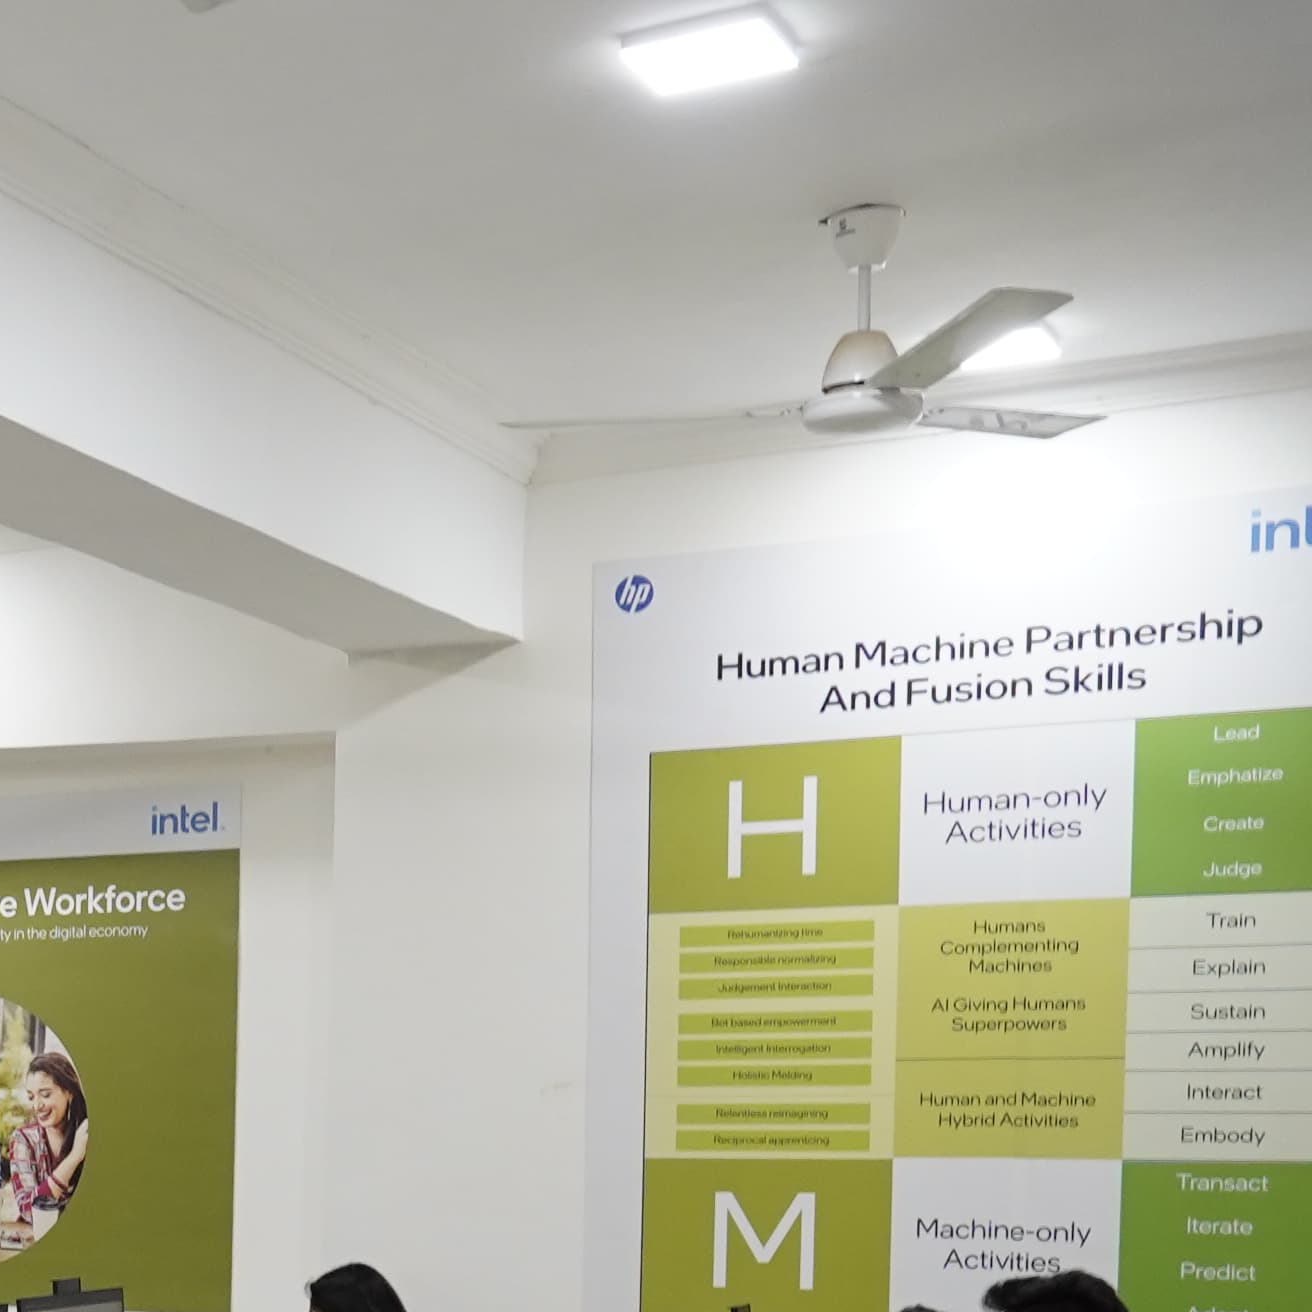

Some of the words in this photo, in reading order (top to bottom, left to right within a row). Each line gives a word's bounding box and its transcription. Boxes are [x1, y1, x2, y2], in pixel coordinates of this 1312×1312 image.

[615, 574, 654, 613] hp
[717, 650, 845, 681] Human
[854, 634, 1014, 670] Machine
[1025, 609, 1264, 655] Partnership
[820, 682, 896, 715] And
[906, 673, 1033, 707] Fusion
[1044, 662, 1147, 694] Skills
[1213, 724, 1260, 743] Lead
[1187, 764, 1283, 788] Emphatize
[923, 782, 1107, 816] Human-only
[150, 801, 219, 836] intel
[727, 775, 818, 879] H
[1203, 815, 1265, 834] Create
[945, 817, 1083, 845] Activities
[1203, 859, 1263, 881] Judge
[24, 884, 186, 917] Workforce
[973, 919, 1046, 936] Humans
[1206, 912, 1257, 929] Train
[14, 928, 25, 939] in
[27, 926, 47, 939] the
[50, 925, 87, 941] digital
[89, 926, 148, 939] economy
[940, 938, 1080, 956] Complementing
[969, 957, 1053, 974] Machines
[1191, 957, 1266, 979] Explain
[931, 997, 950, 1013] AI
[954, 996, 1007, 1017] Giving
[1011, 996, 1087, 1012] Humans
[1190, 1002, 1265, 1020] Sustain
[952, 1016, 1068, 1035] Superpowers
[1187, 1040, 1265, 1063] Amplify
[919, 1092, 979, 1108] Human
[984, 1092, 1016, 1107] and
[1021, 1092, 1096, 1107] Machine
[1186, 1084, 1263, 1101] Interact
[938, 1111, 995, 1130] Hybrid
[999, 1112, 1079, 1128] Activities
[1180, 1126, 1265, 1148] Embody
[1176, 1173, 1269, 1192] Transact
[916, 1218, 1091, 1249] Machine-only
[1186, 1218, 1253, 1236] Iterate
[712, 1191, 816, 1291] M
[943, 1249, 1061, 1274] Activities
[1179, 1262, 1256, 1281] Predict
